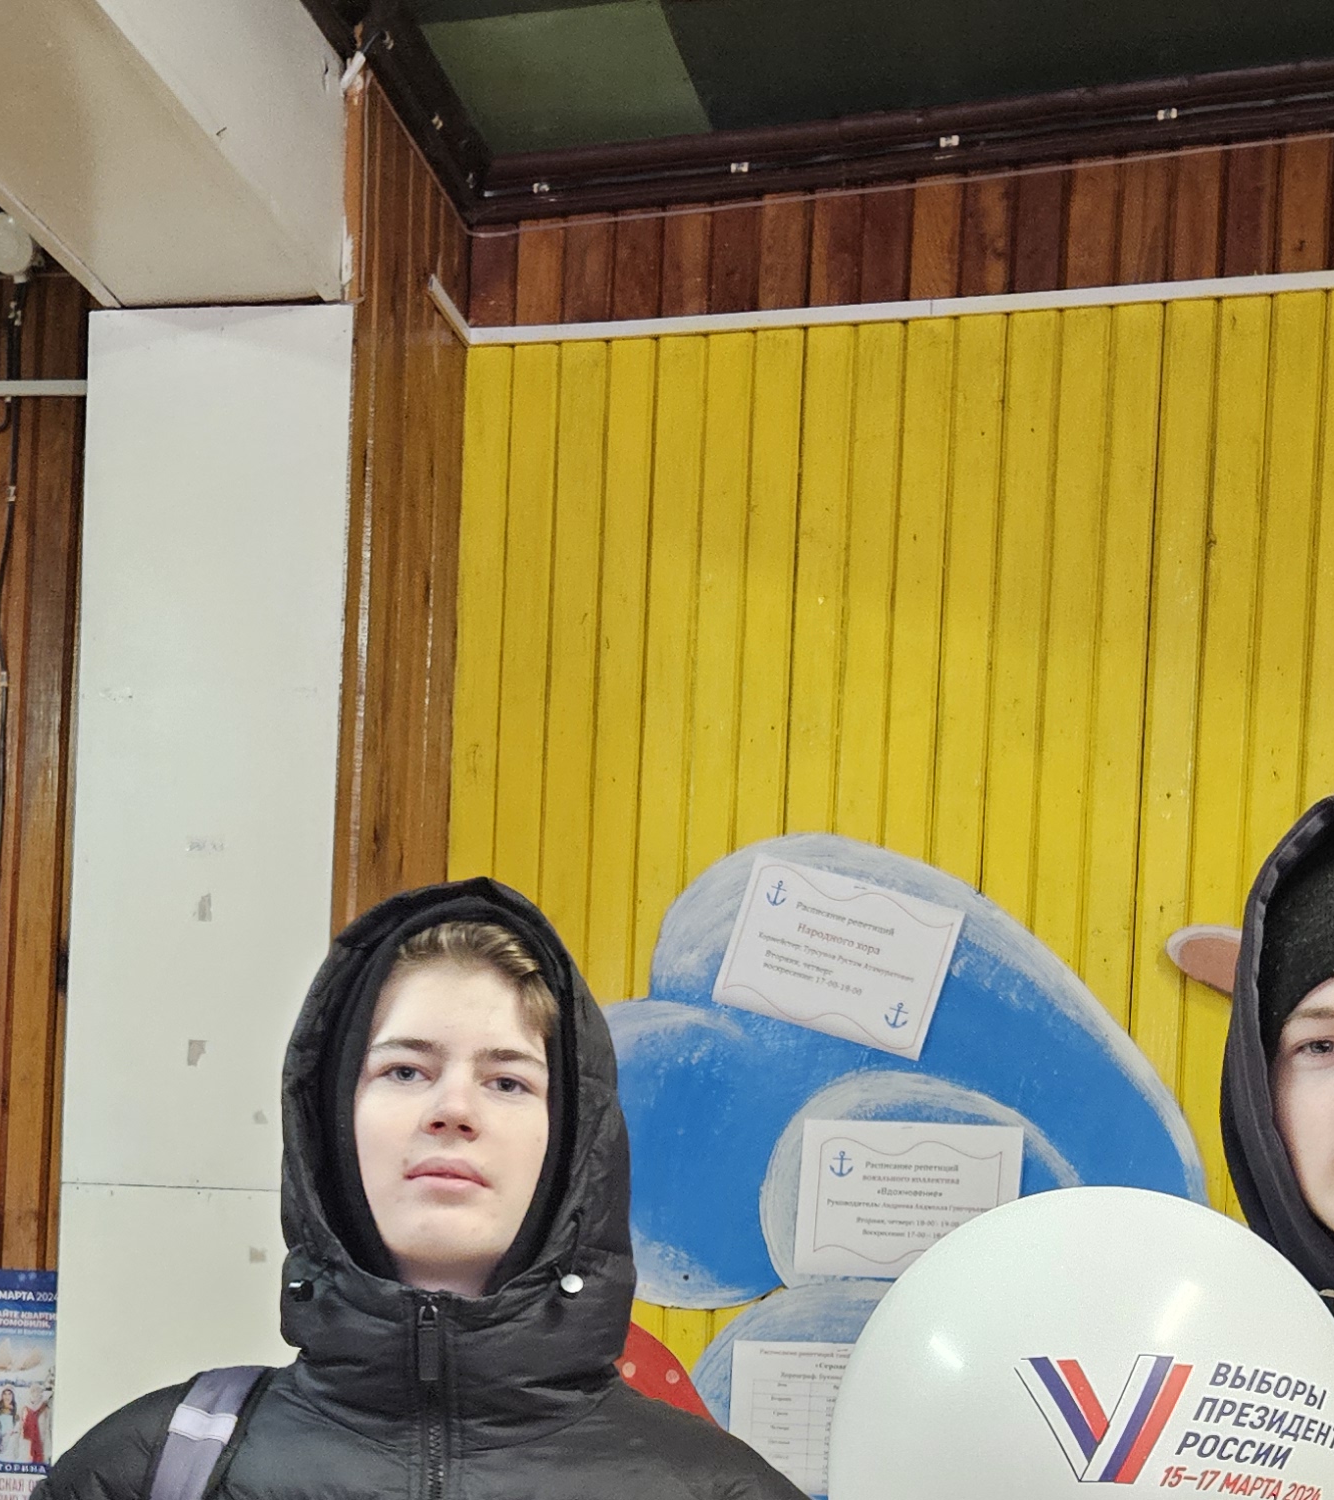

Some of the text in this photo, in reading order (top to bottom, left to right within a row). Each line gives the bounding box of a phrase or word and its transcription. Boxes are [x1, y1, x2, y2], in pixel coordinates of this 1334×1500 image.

[797, 922, 880, 955] Народного хора
[1209, 1362, 1326, 1411] ВЫБОРЫ
[1175, 1431, 1294, 1471] РОССИИ
